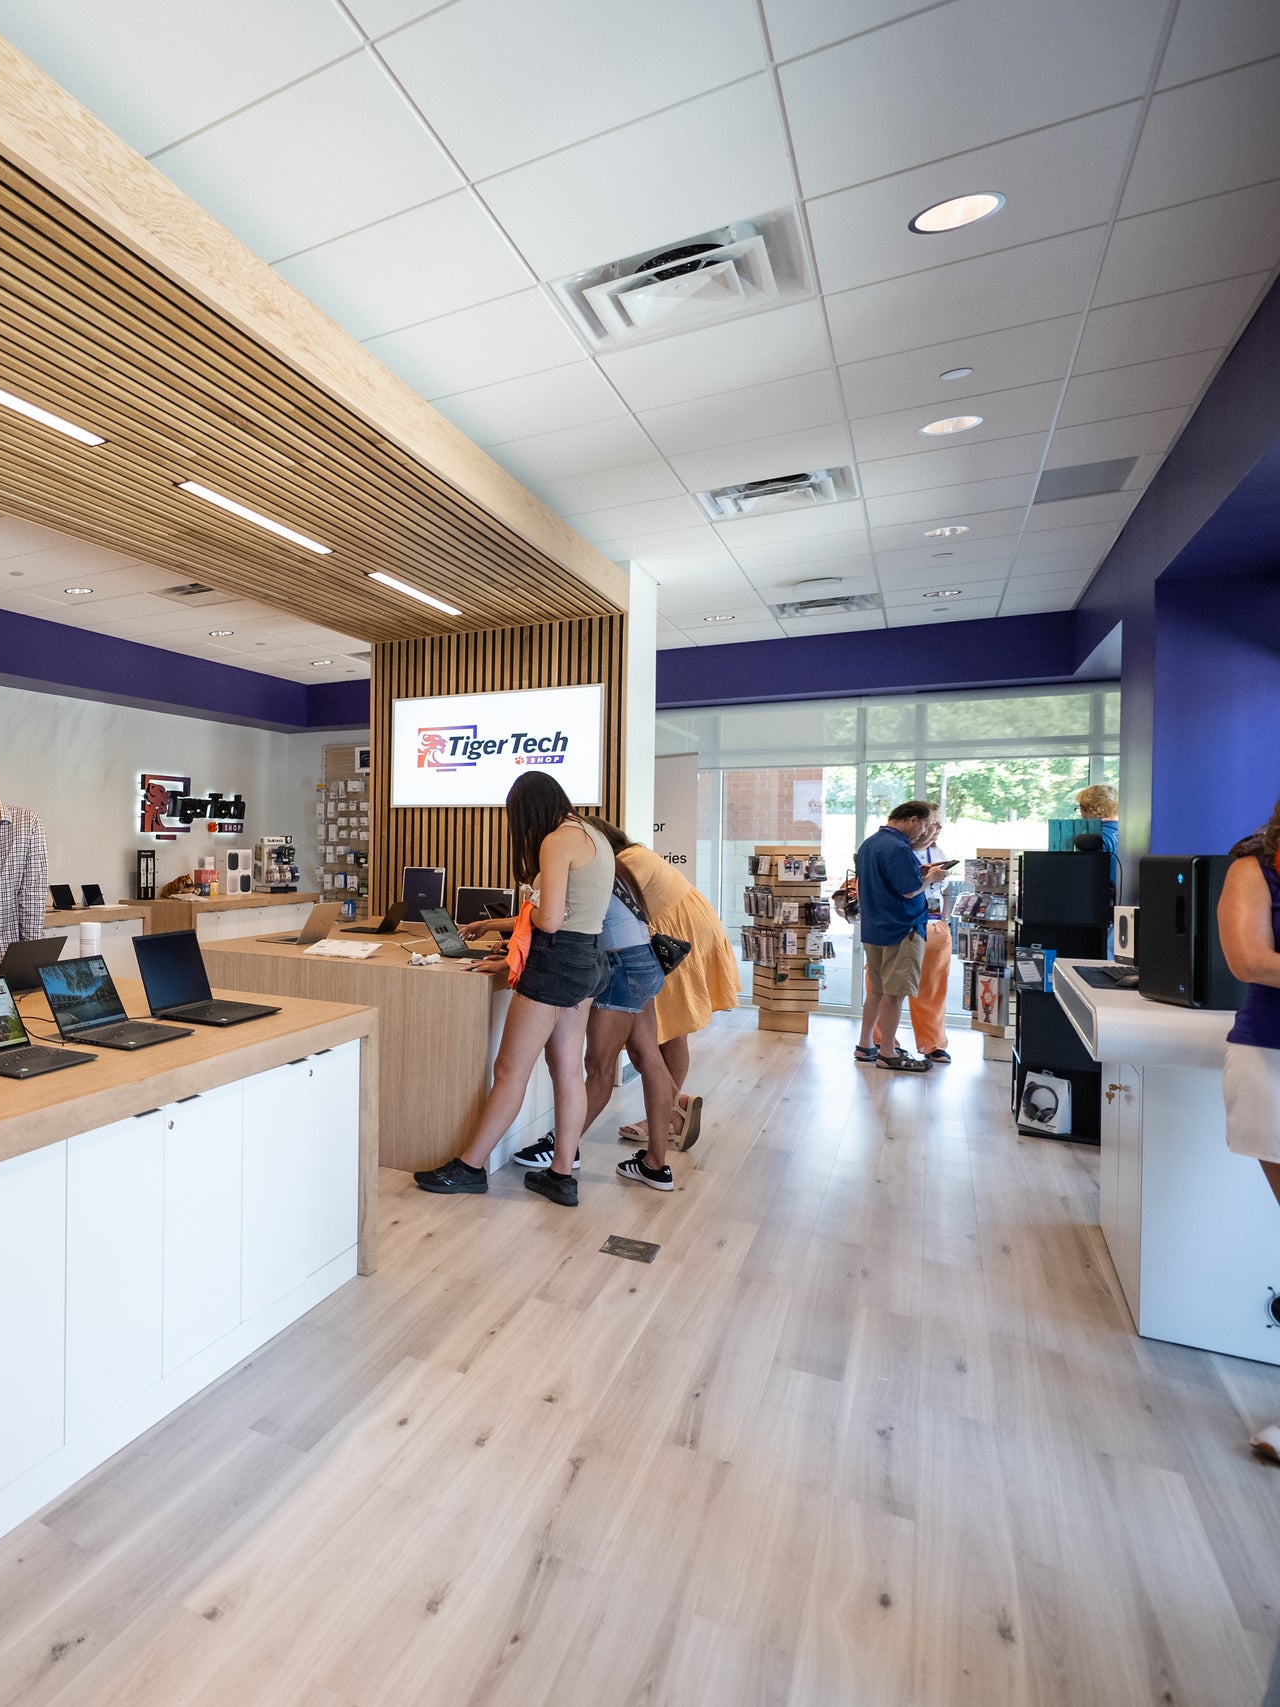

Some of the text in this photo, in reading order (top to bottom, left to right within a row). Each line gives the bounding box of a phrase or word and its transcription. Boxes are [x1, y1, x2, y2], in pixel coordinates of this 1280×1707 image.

[449, 731, 569, 760] Tiger Tech
[530, 756, 560, 764] SHOP
[660, 852, 687, 864] ries
